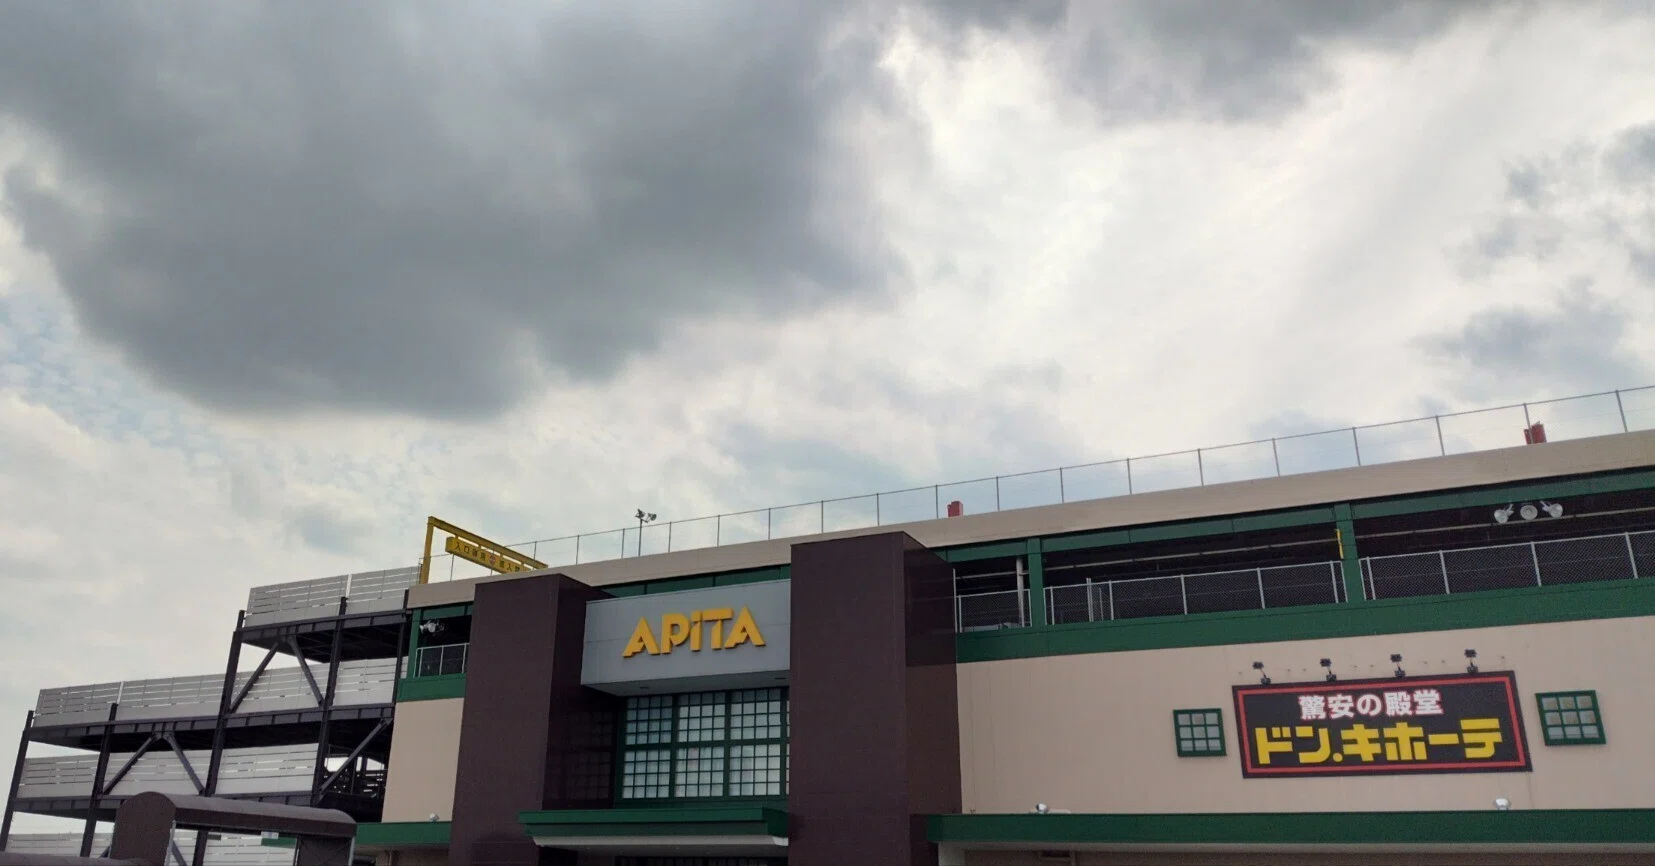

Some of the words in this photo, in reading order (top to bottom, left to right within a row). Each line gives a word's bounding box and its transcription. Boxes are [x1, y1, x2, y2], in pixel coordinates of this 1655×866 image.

[1298, 689, 1444, 721] 驚安の殿堂
